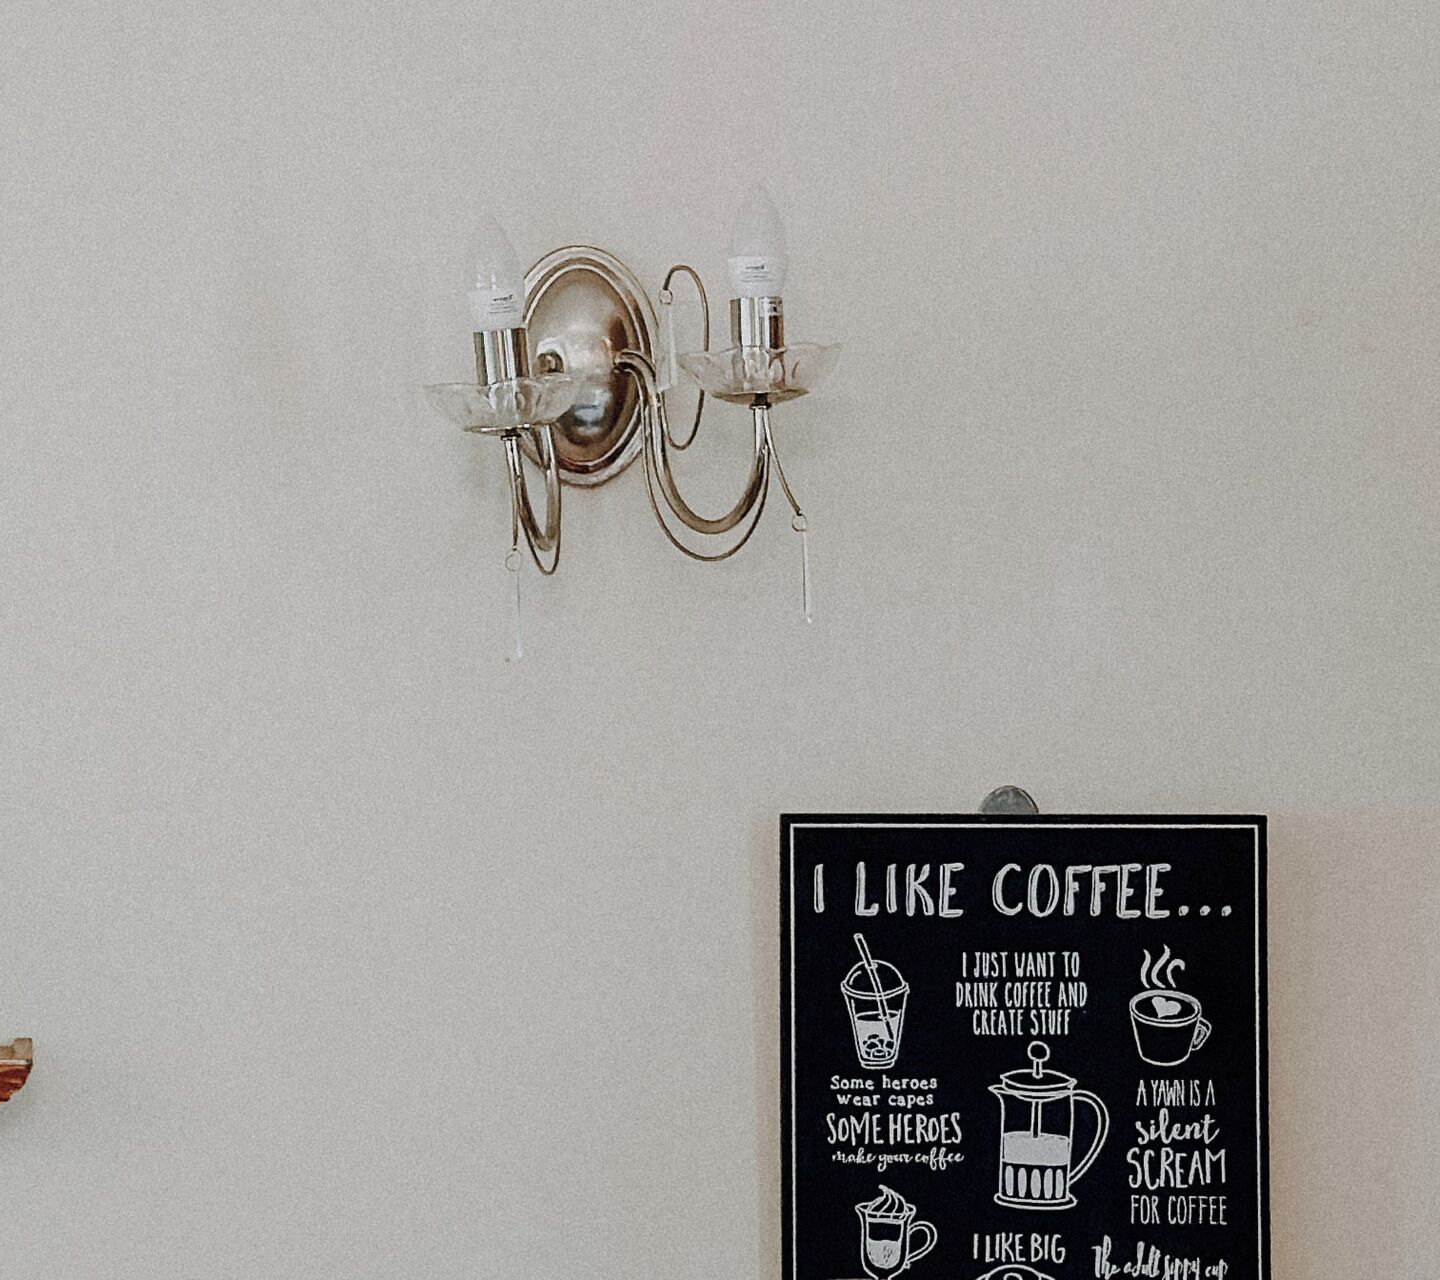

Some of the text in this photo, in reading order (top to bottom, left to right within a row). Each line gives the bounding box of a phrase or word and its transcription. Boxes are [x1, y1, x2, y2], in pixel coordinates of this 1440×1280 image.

[814, 862, 825, 914] I
[854, 860, 965, 917] LIKE
[962, 951, 1080, 978] I JUST WANT TO
[956, 980, 1087, 1008] DRINK COFFEE AND
[972, 1009, 1071, 1037] CREATE STUFF
[830, 1075, 937, 1090] Some heroes
[1136, 1080, 1216, 1106] A YAWN IS A
[837, 1092, 934, 1108] wear capes
[827, 1112, 963, 1146] SOME HEROES
[1135, 1108, 1220, 1145] silent
[832, 1147, 964, 1172] make your coffee
[1128, 1149, 1227, 1190] SCREAM
[1130, 1196, 1227, 1225] FOR COFFEE
[973, 1233, 1065, 1263] I LIKE BIG
[1091, 1235, 1121, 1280] The
